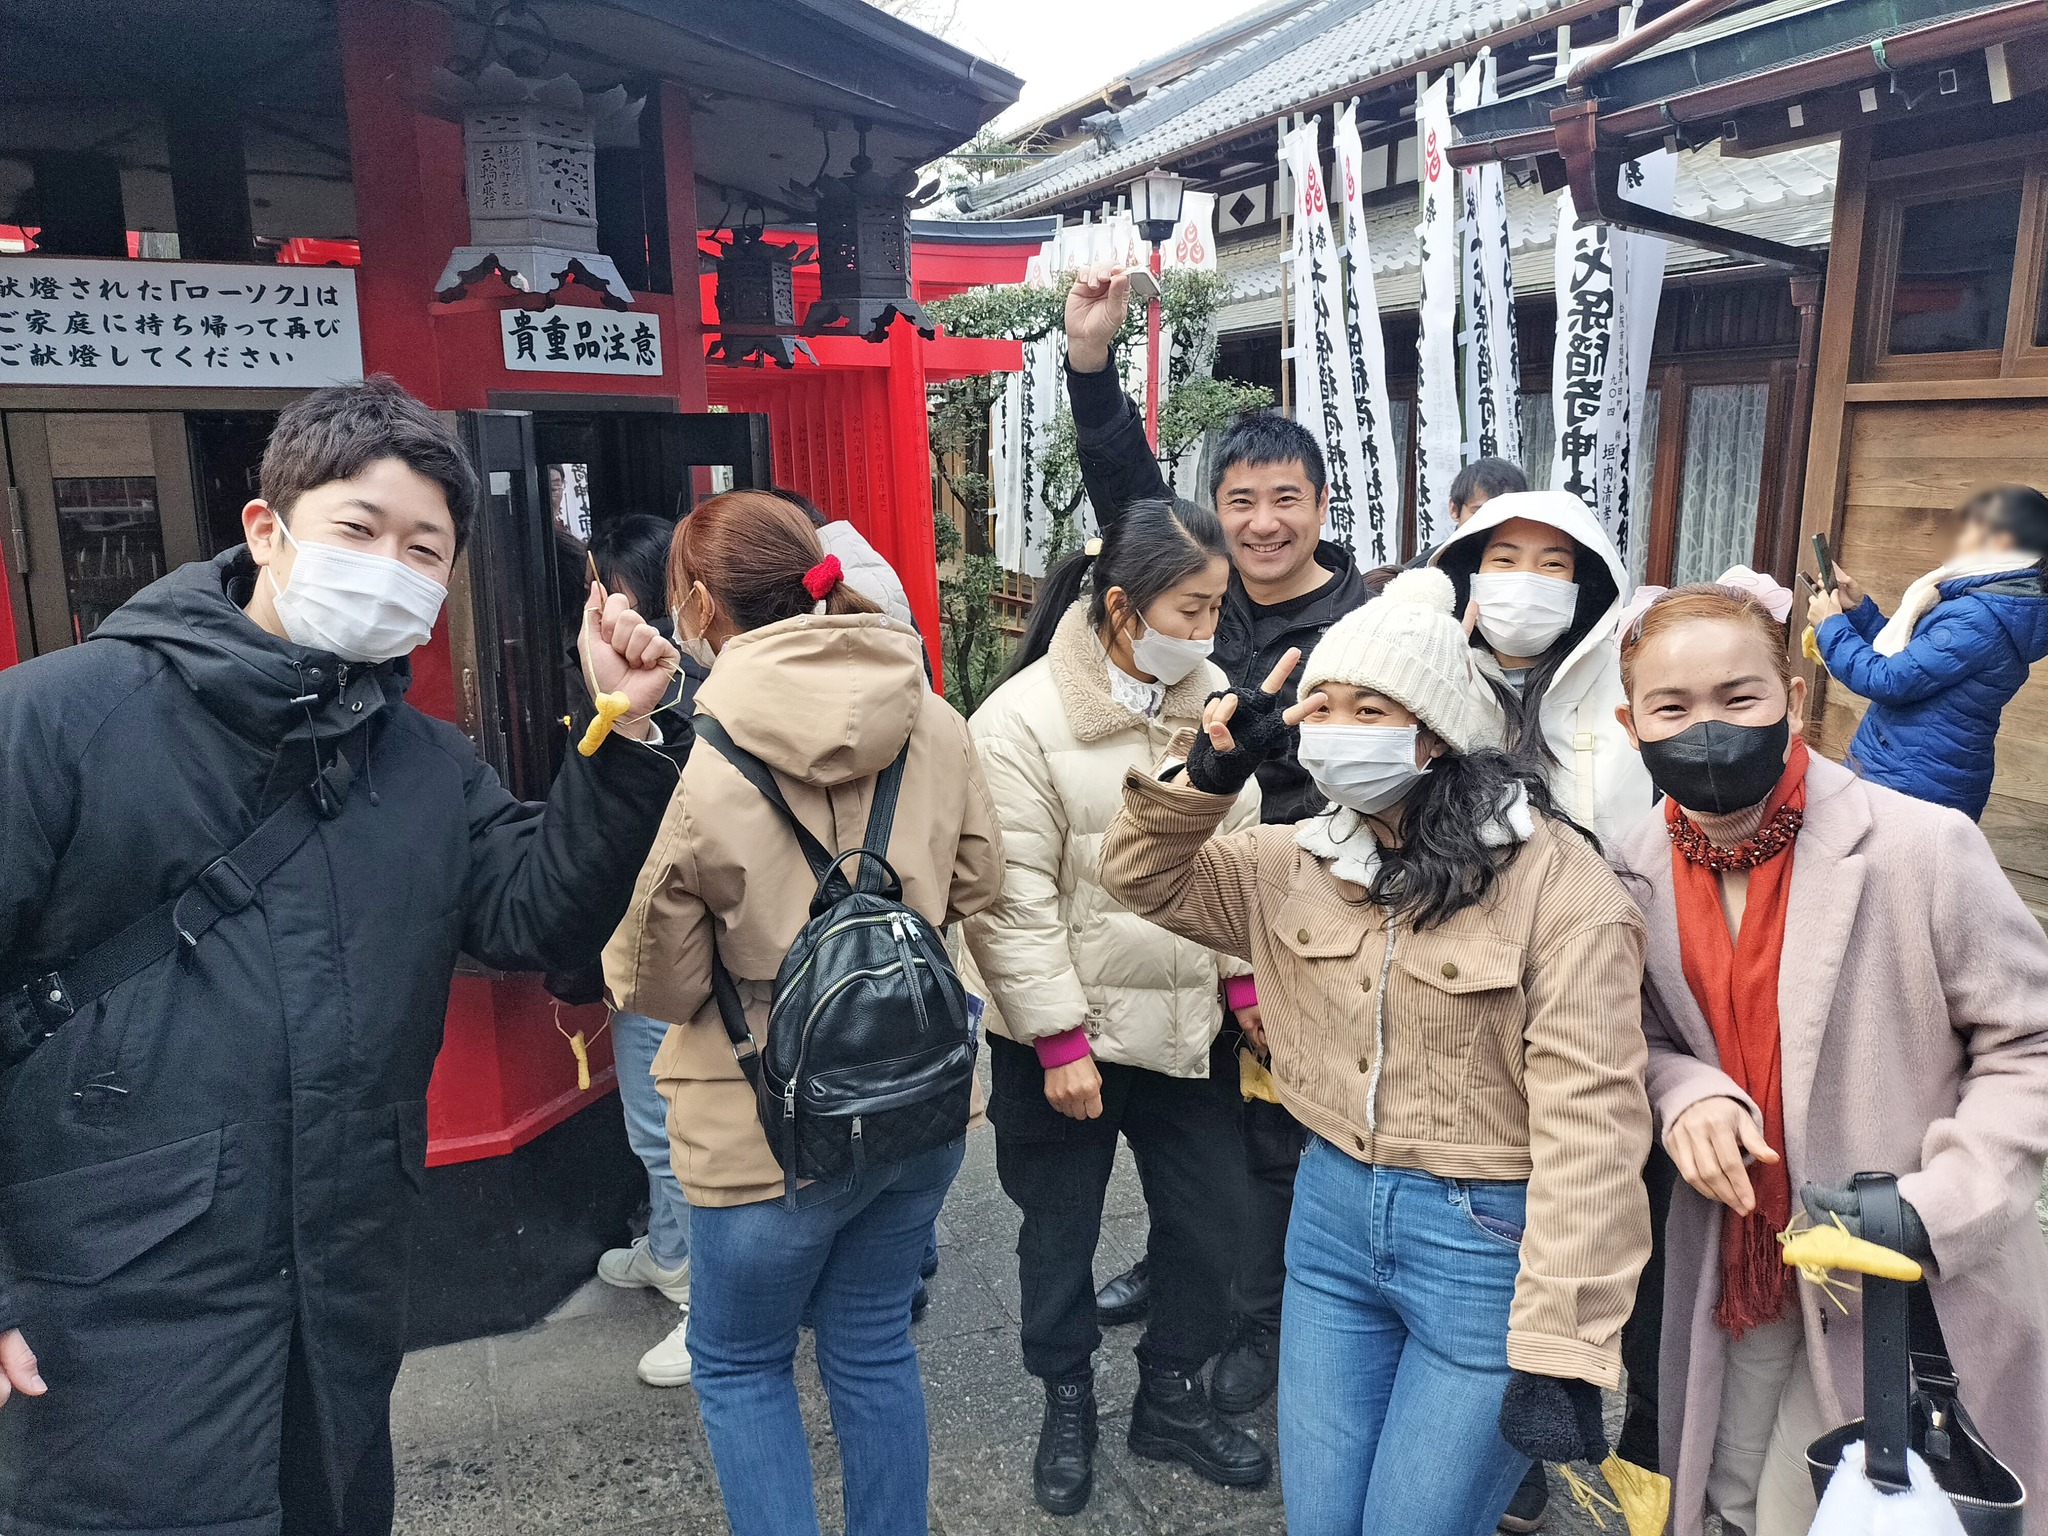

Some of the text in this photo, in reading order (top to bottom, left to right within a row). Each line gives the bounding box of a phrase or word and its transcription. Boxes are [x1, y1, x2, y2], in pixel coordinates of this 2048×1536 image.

[0, 276, 339, 307] 献燈された「ローソク」は
[0, 309, 340, 340] ご家庭に持ち帰って再び
[508, 310, 656, 367] 貴重品注意
[0, 342, 294, 369] ご献燈してください
